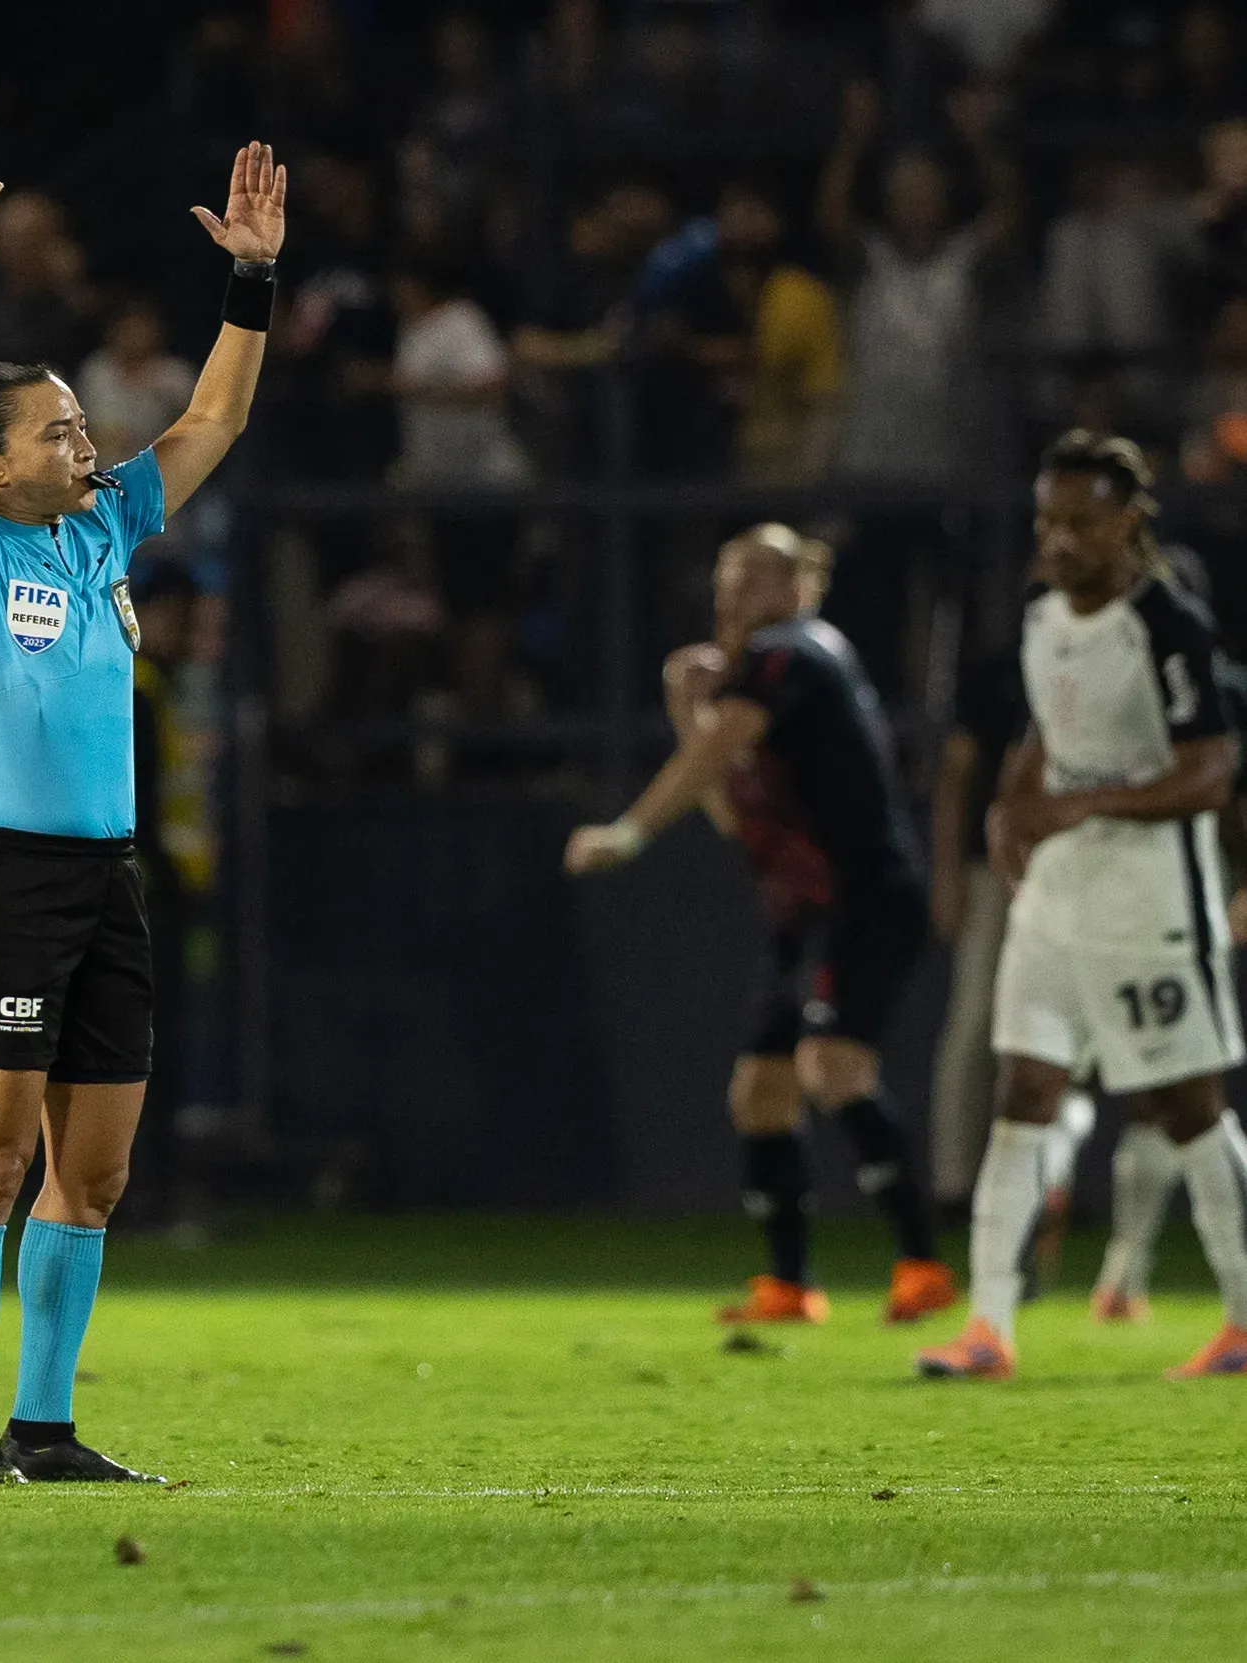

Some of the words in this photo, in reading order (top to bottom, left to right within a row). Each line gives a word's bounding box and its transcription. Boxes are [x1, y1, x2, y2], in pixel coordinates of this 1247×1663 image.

[14, 585, 62, 609] FIFA
[12, 613, 60, 628] REFEREE
[22, 637, 46, 648] 2025
[0, 996, 44, 1018] CBF
[1116, 976, 1189, 1031] 19
